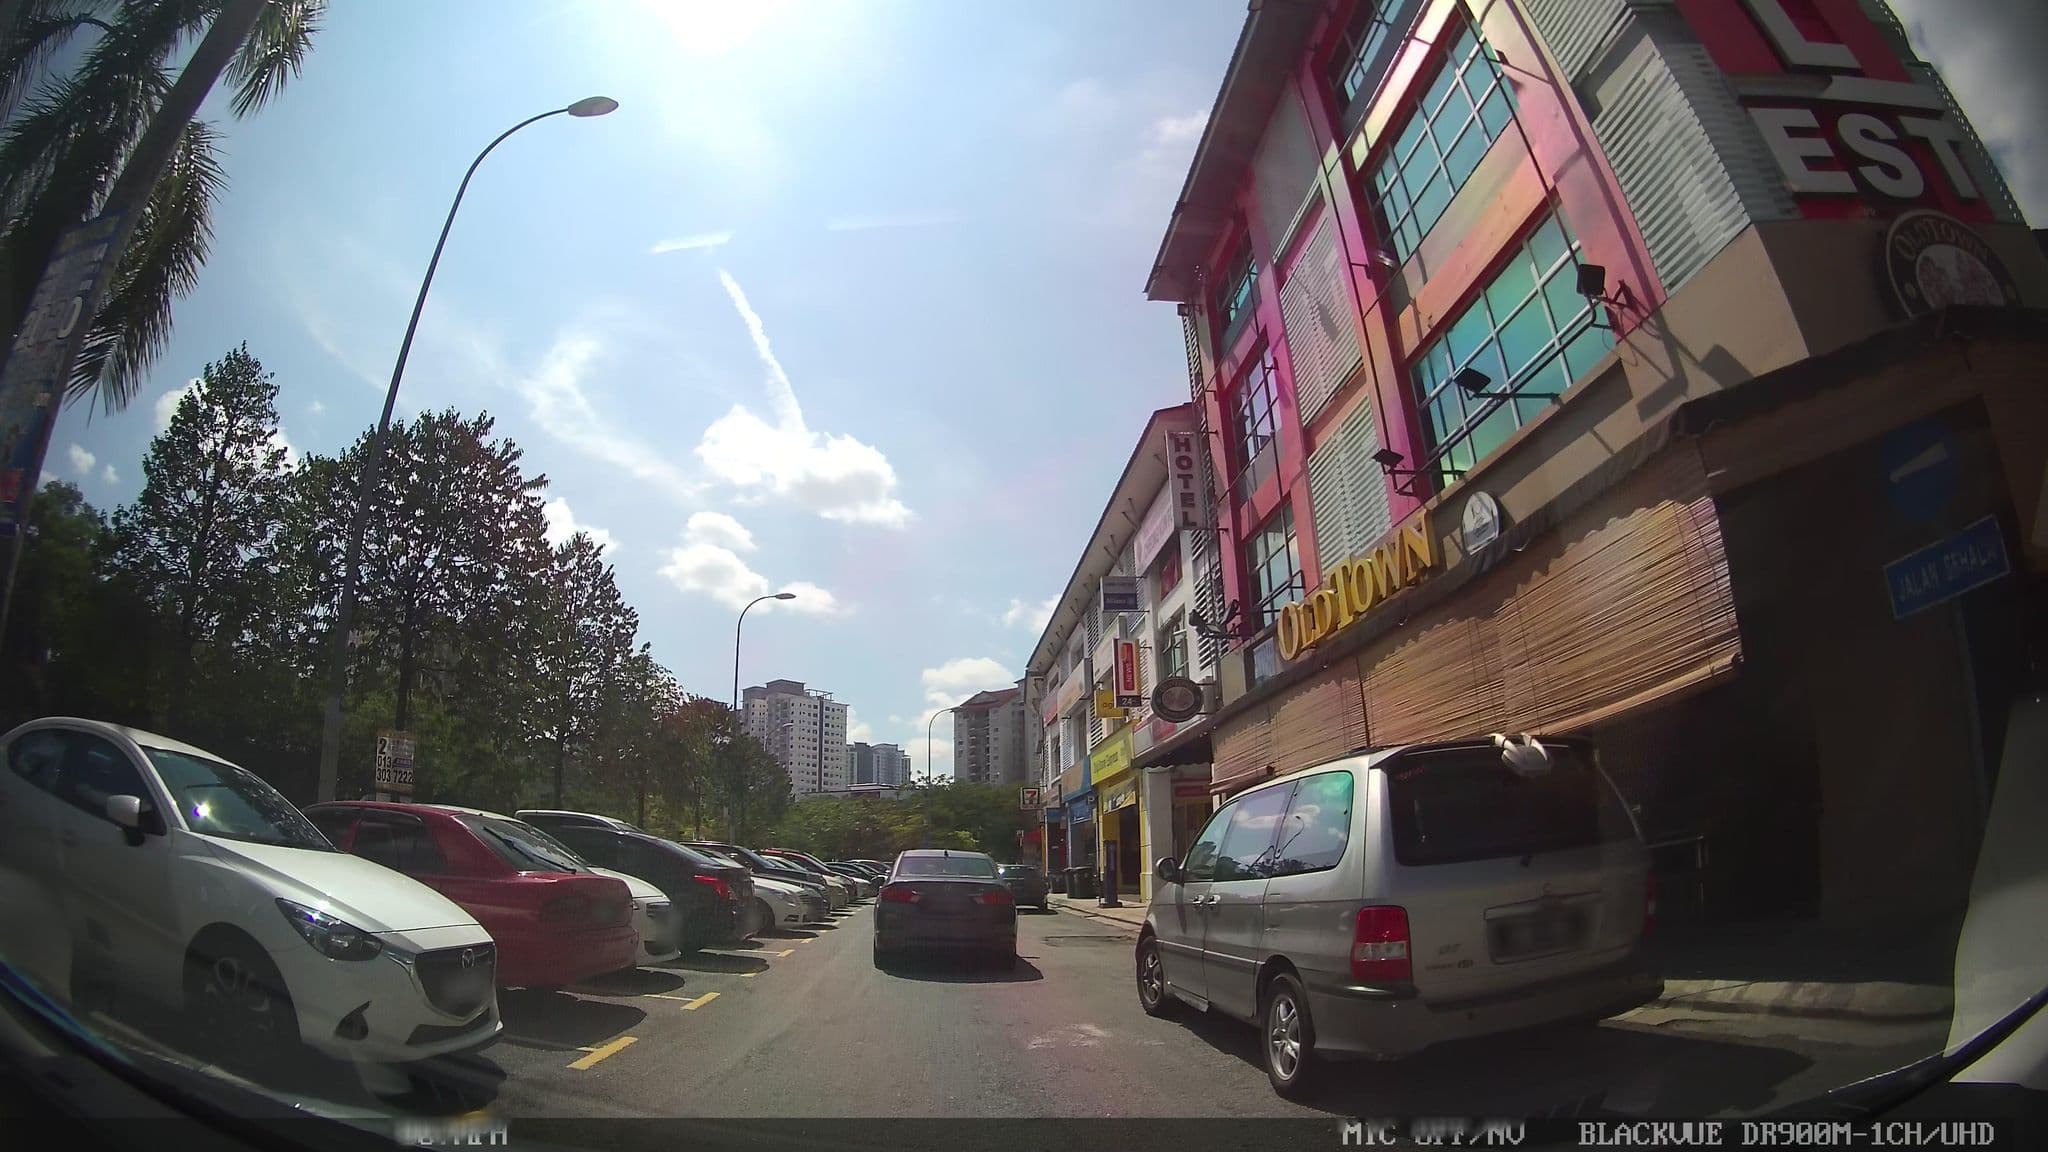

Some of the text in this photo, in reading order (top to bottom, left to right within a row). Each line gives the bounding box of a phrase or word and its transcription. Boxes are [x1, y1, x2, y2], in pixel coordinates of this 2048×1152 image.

[1747, 107, 1982, 200] EST
[1174, 437, 1197, 527] HOTEL
[379, 738, 387, 755] 2
[377, 755, 392, 768] 013
[376, 769, 414, 784] 303 7222
